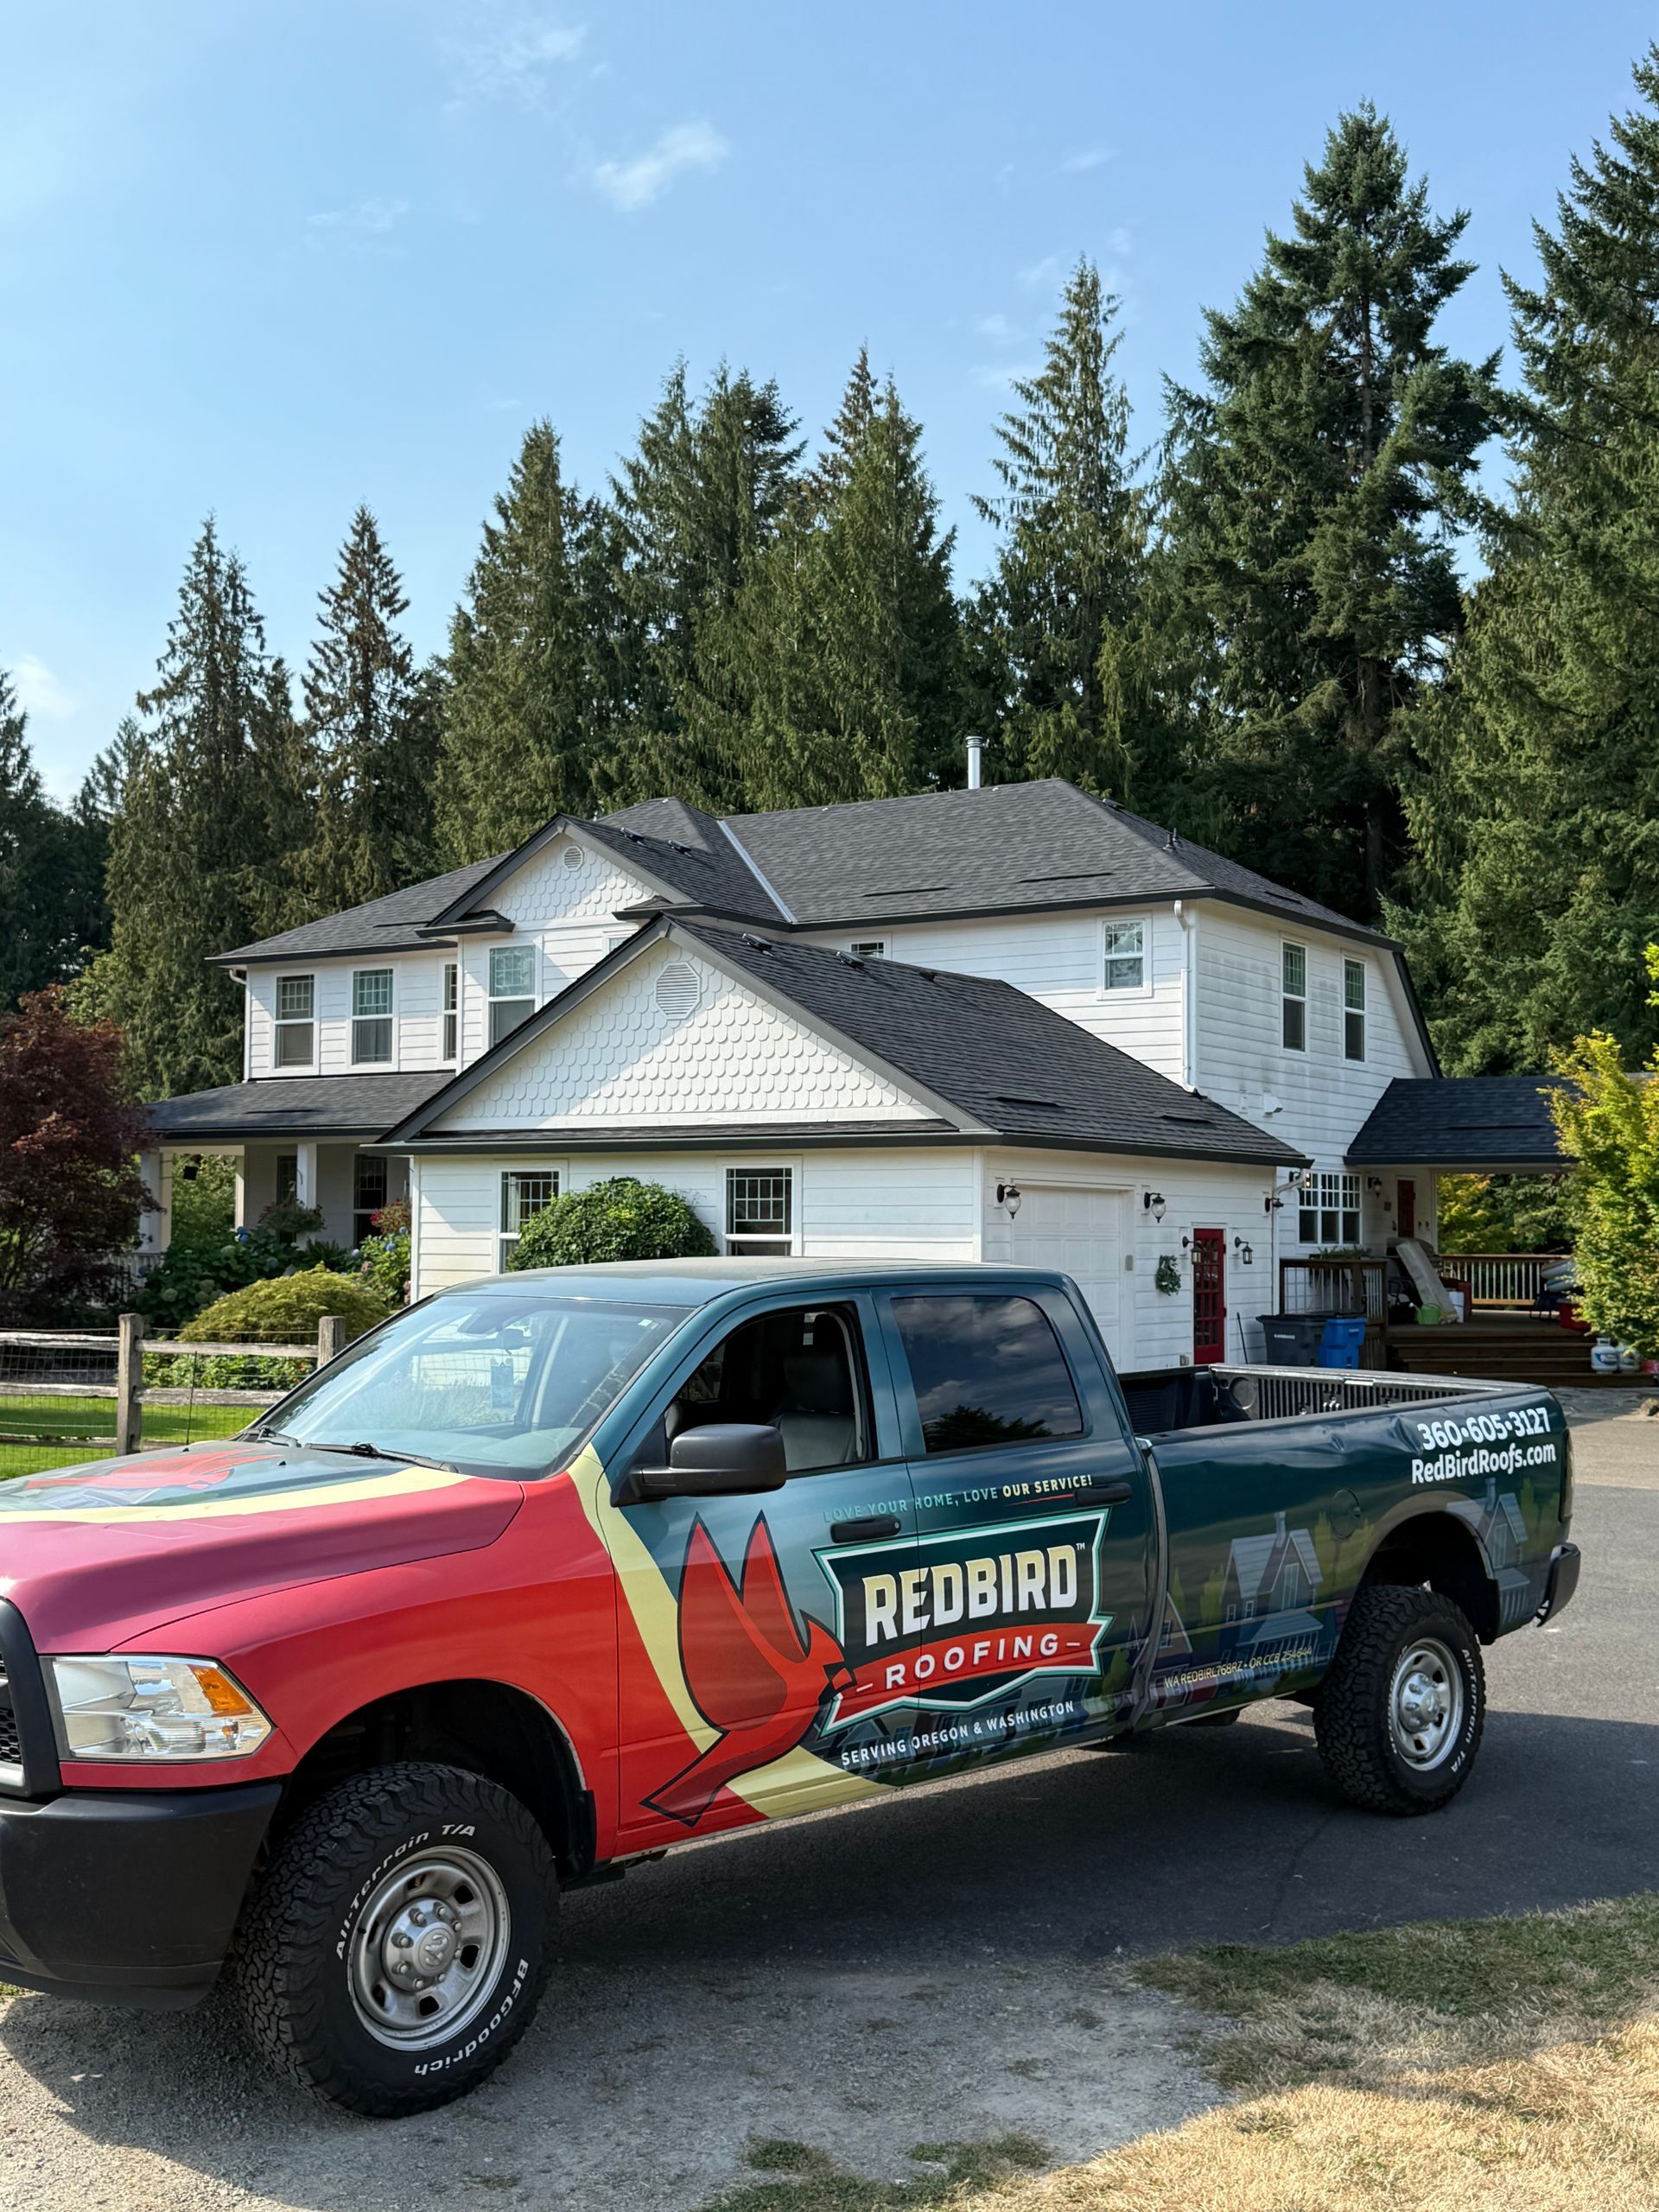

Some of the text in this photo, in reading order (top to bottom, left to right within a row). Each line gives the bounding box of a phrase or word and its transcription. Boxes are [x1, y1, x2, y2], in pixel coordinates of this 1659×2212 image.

[1412, 1442, 1556, 1484] RedBirdRoofs.com
[823, 1474, 1093, 1522] LOVE YOUR HOME, LOVE OUR SERVICE!
[861, 1543, 1077, 1647] REDBIRD
[885, 1632, 1058, 1690] ROOFING
[1164, 1676, 1180, 1688] WA
[1249, 1656, 1263, 1669] OR
[1263, 1652, 1279, 1665] CCB
[841, 1700, 1075, 1766] SERVING OREGON & WASHINGTON
[1450, 1648, 1479, 1774] All-Terrain T/A
[335, 1823, 476, 1961] All-Terrain T/A
[414, 1958, 529, 2076] BFGoodrich
